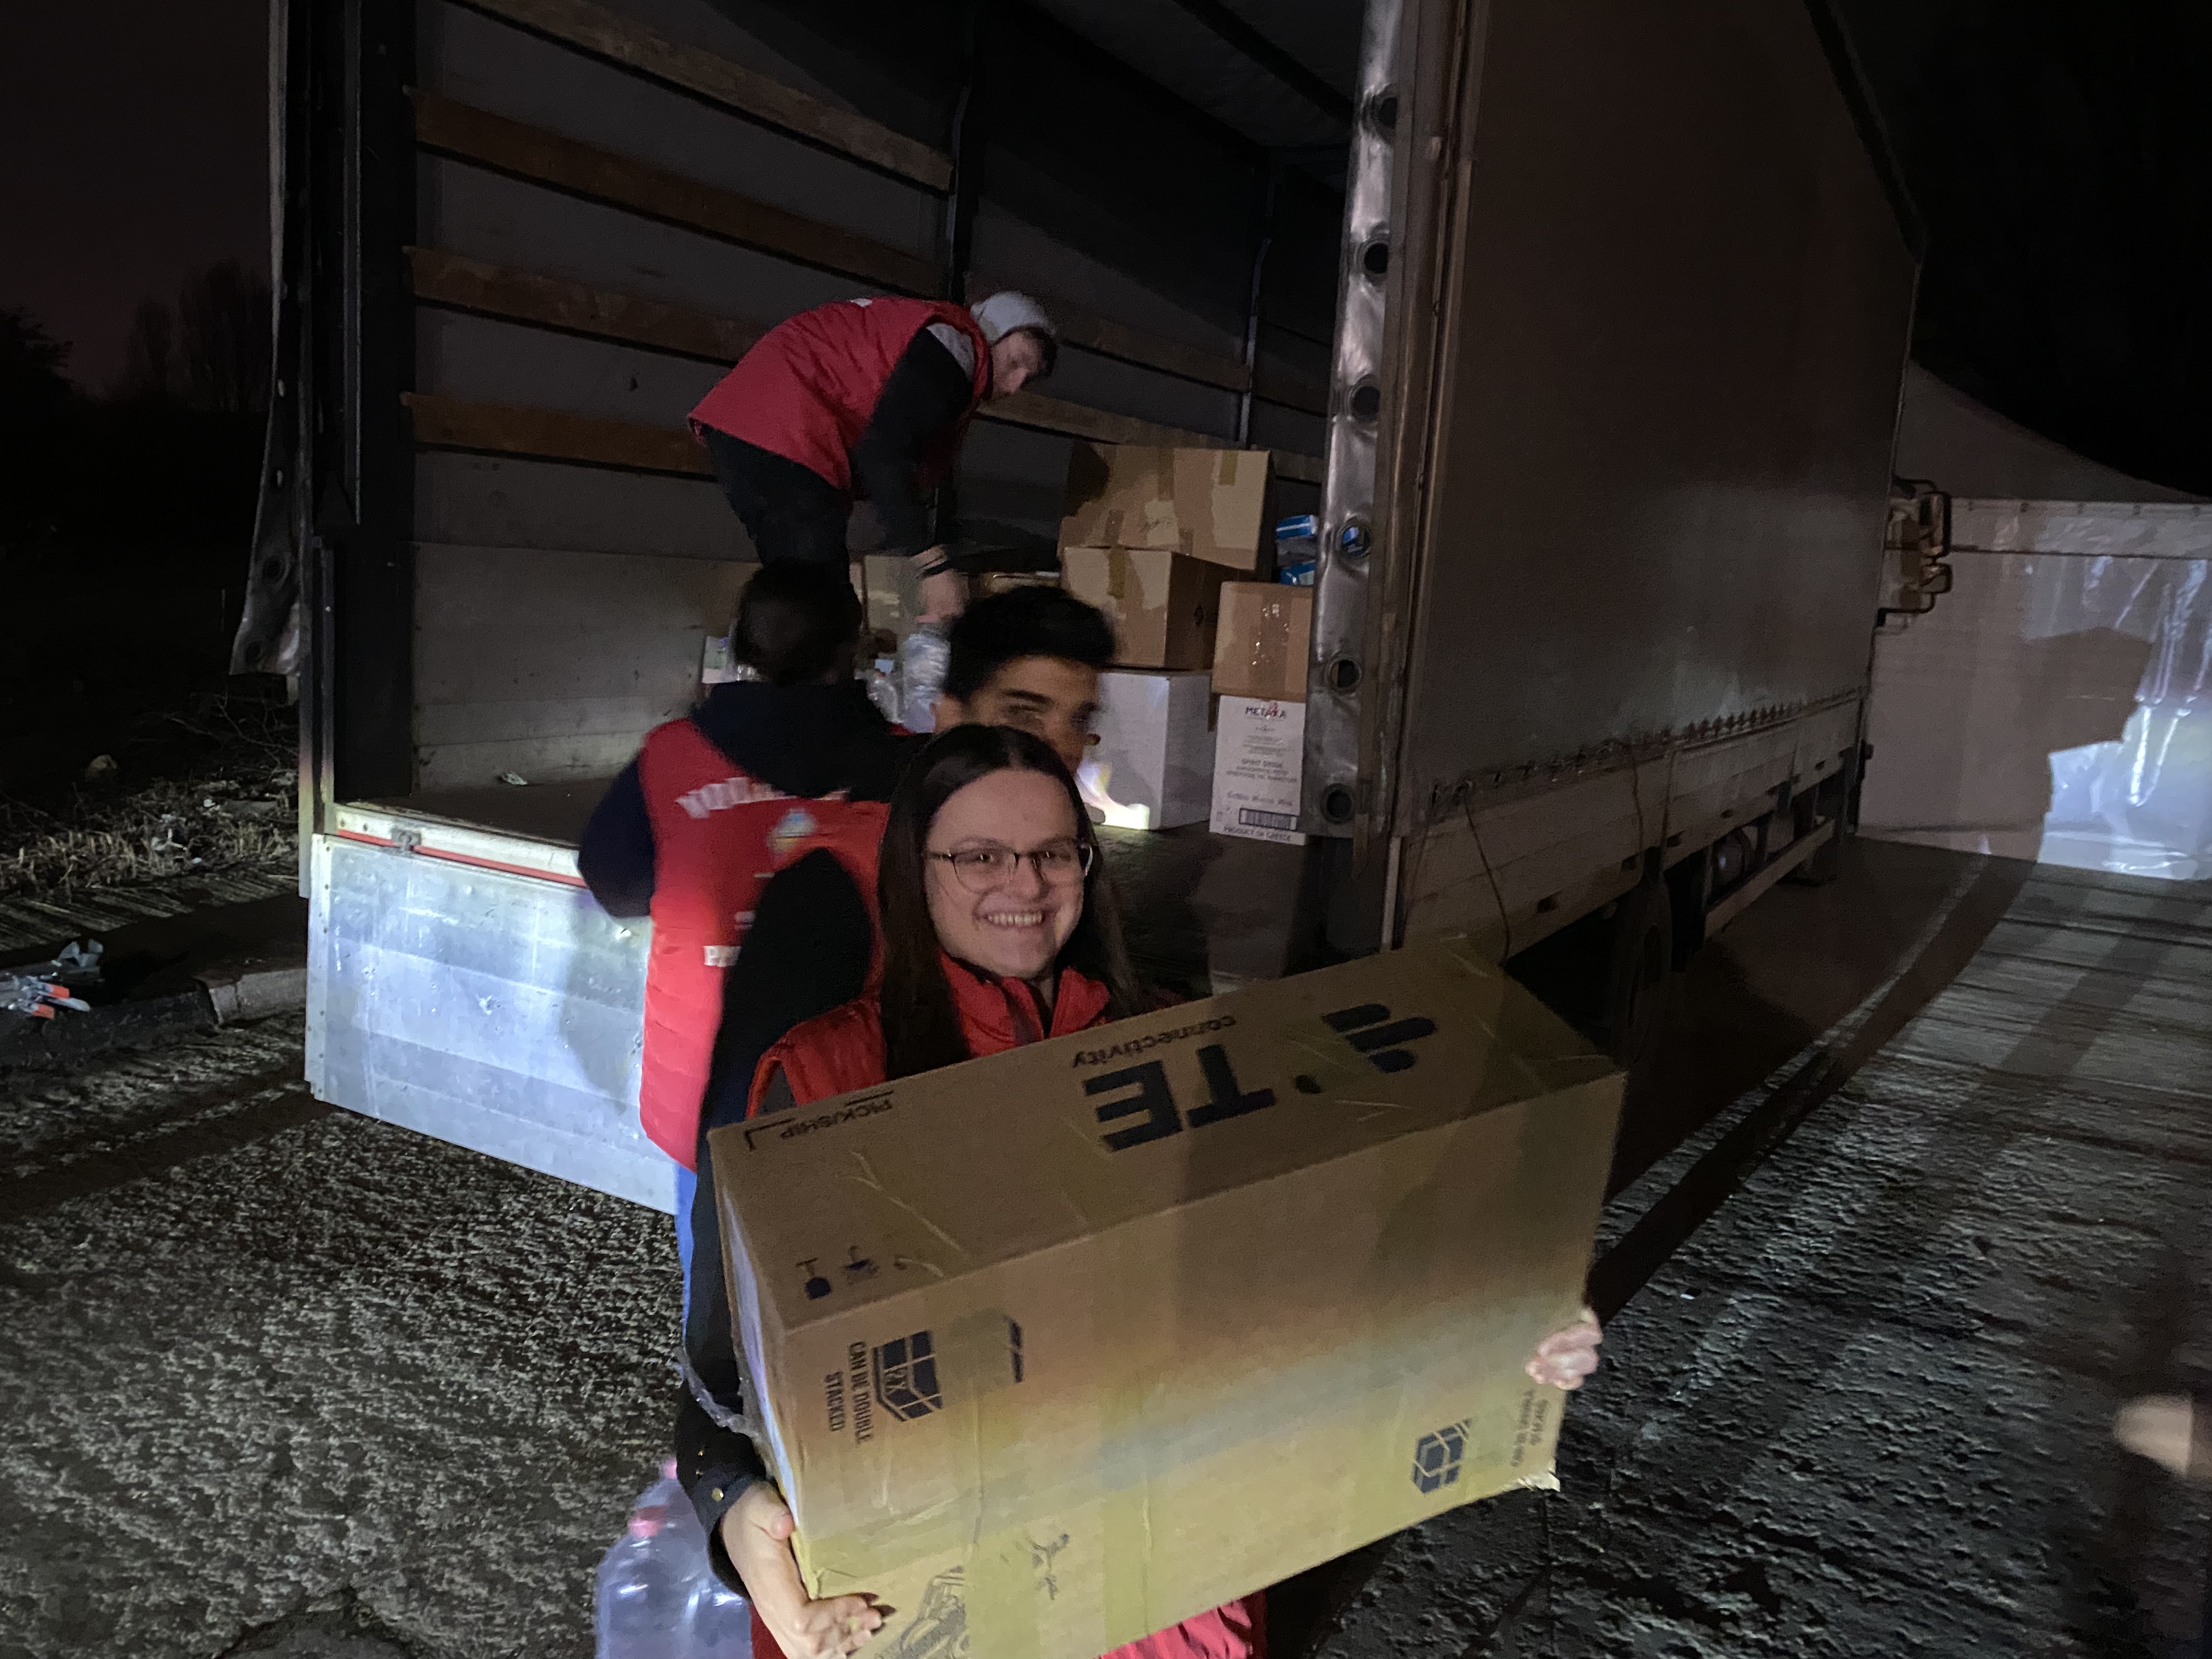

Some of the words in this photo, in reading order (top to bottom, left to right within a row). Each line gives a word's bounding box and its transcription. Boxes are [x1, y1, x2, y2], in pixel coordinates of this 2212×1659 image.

[1072, 1015, 1237, 1068] connectivity
[780, 1099, 893, 1139] PICK/SHIP
[1083, 1043, 1276, 1152] TE
[849, 1340, 867, 1371] CAN
[824, 1371, 845, 1432] STACKED
[853, 1391, 874, 1444] DOUBLE
